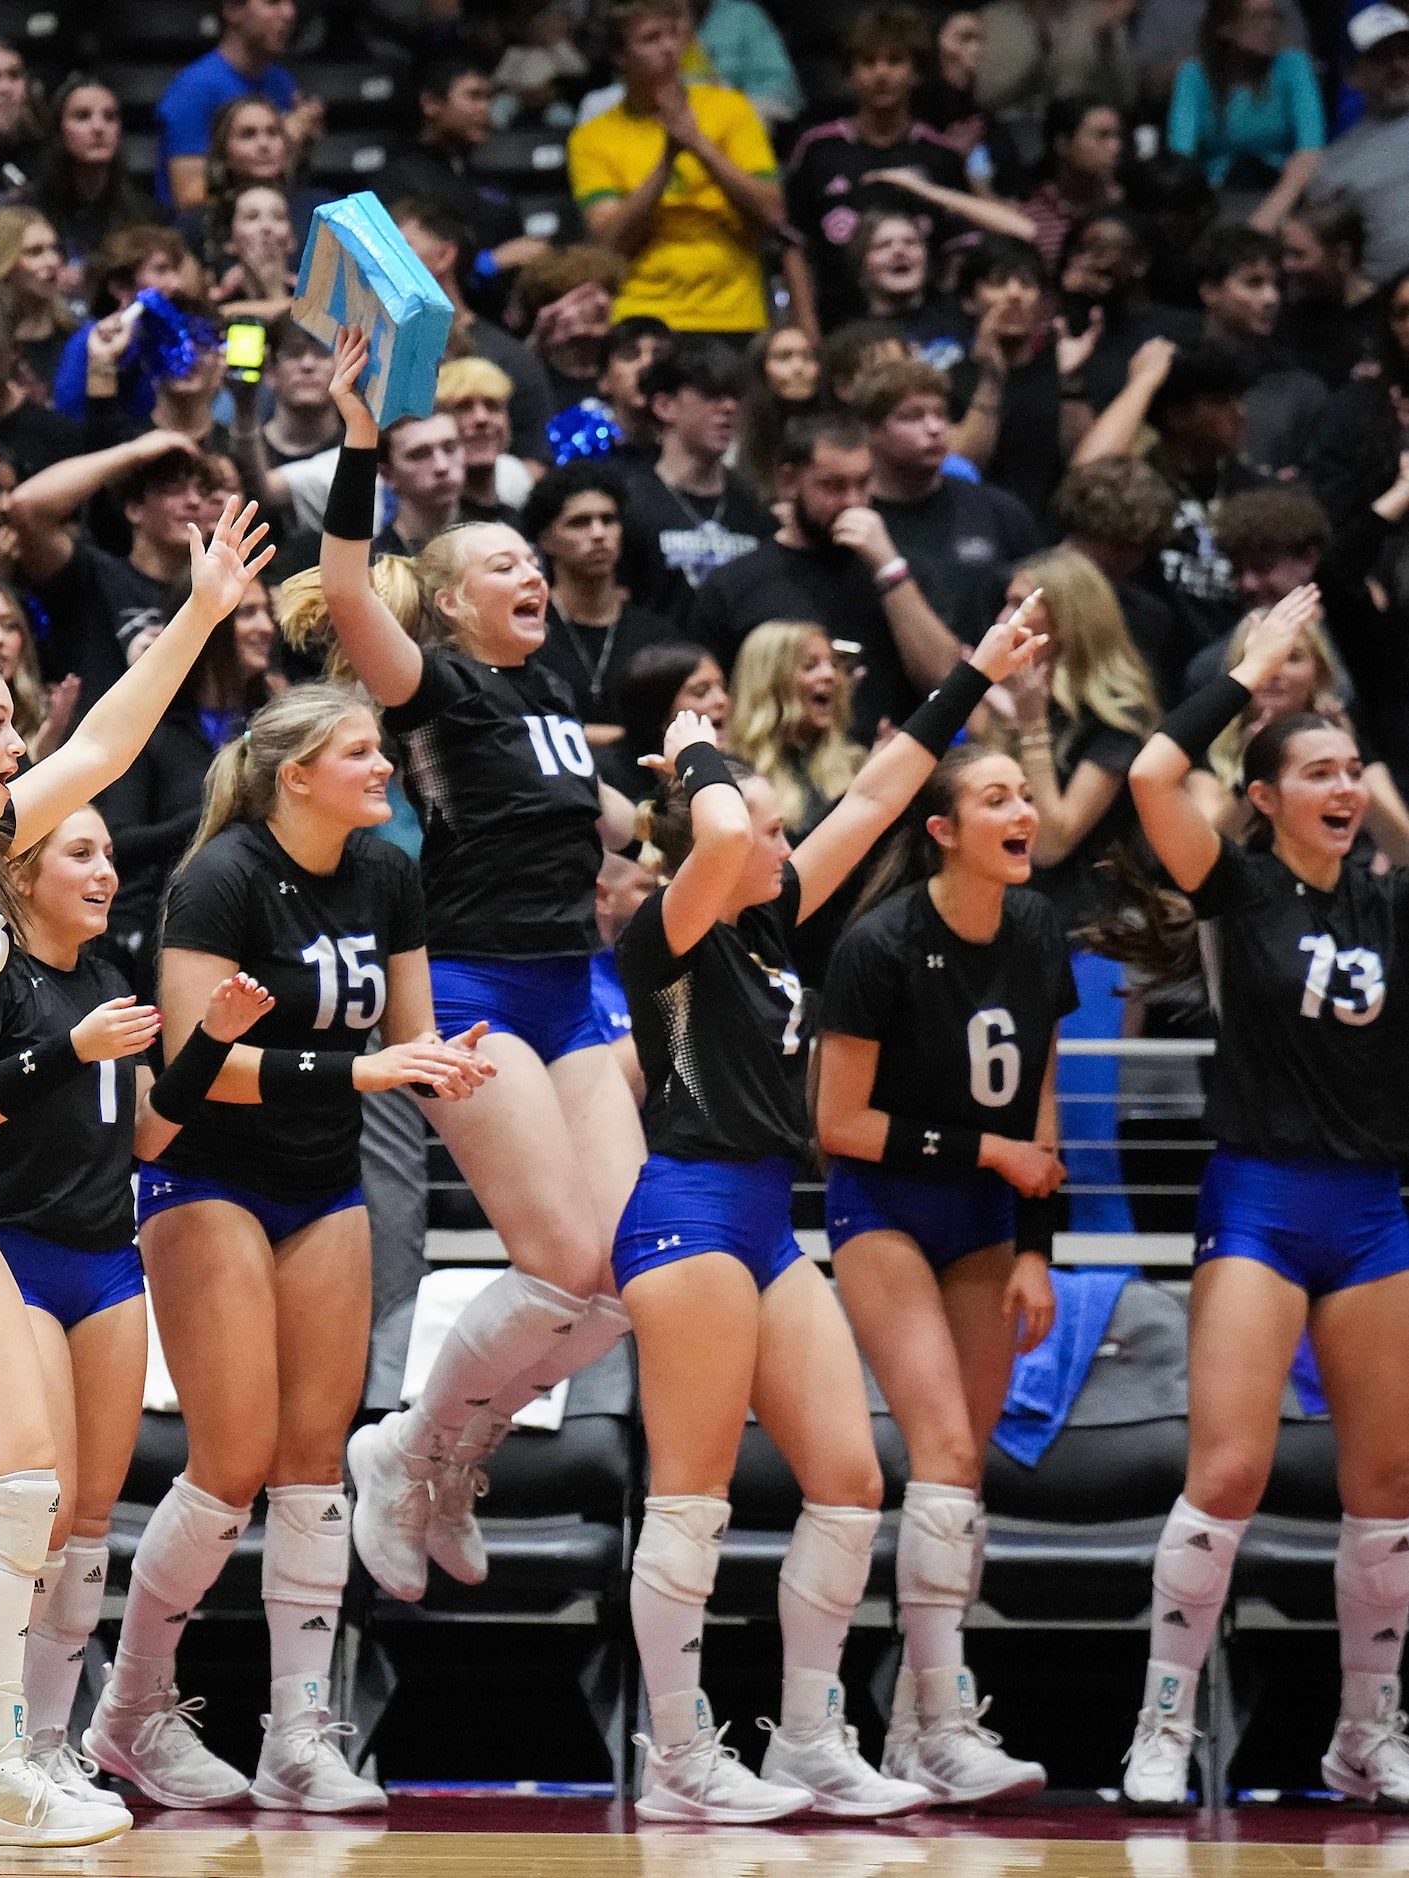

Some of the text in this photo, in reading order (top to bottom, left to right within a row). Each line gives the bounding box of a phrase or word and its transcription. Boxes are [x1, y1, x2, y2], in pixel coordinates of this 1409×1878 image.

[521, 713, 595, 778] 16
[300, 932, 387, 1030] 15
[1298, 933, 1386, 1027] 13
[967, 1007, 1022, 1107] 6
